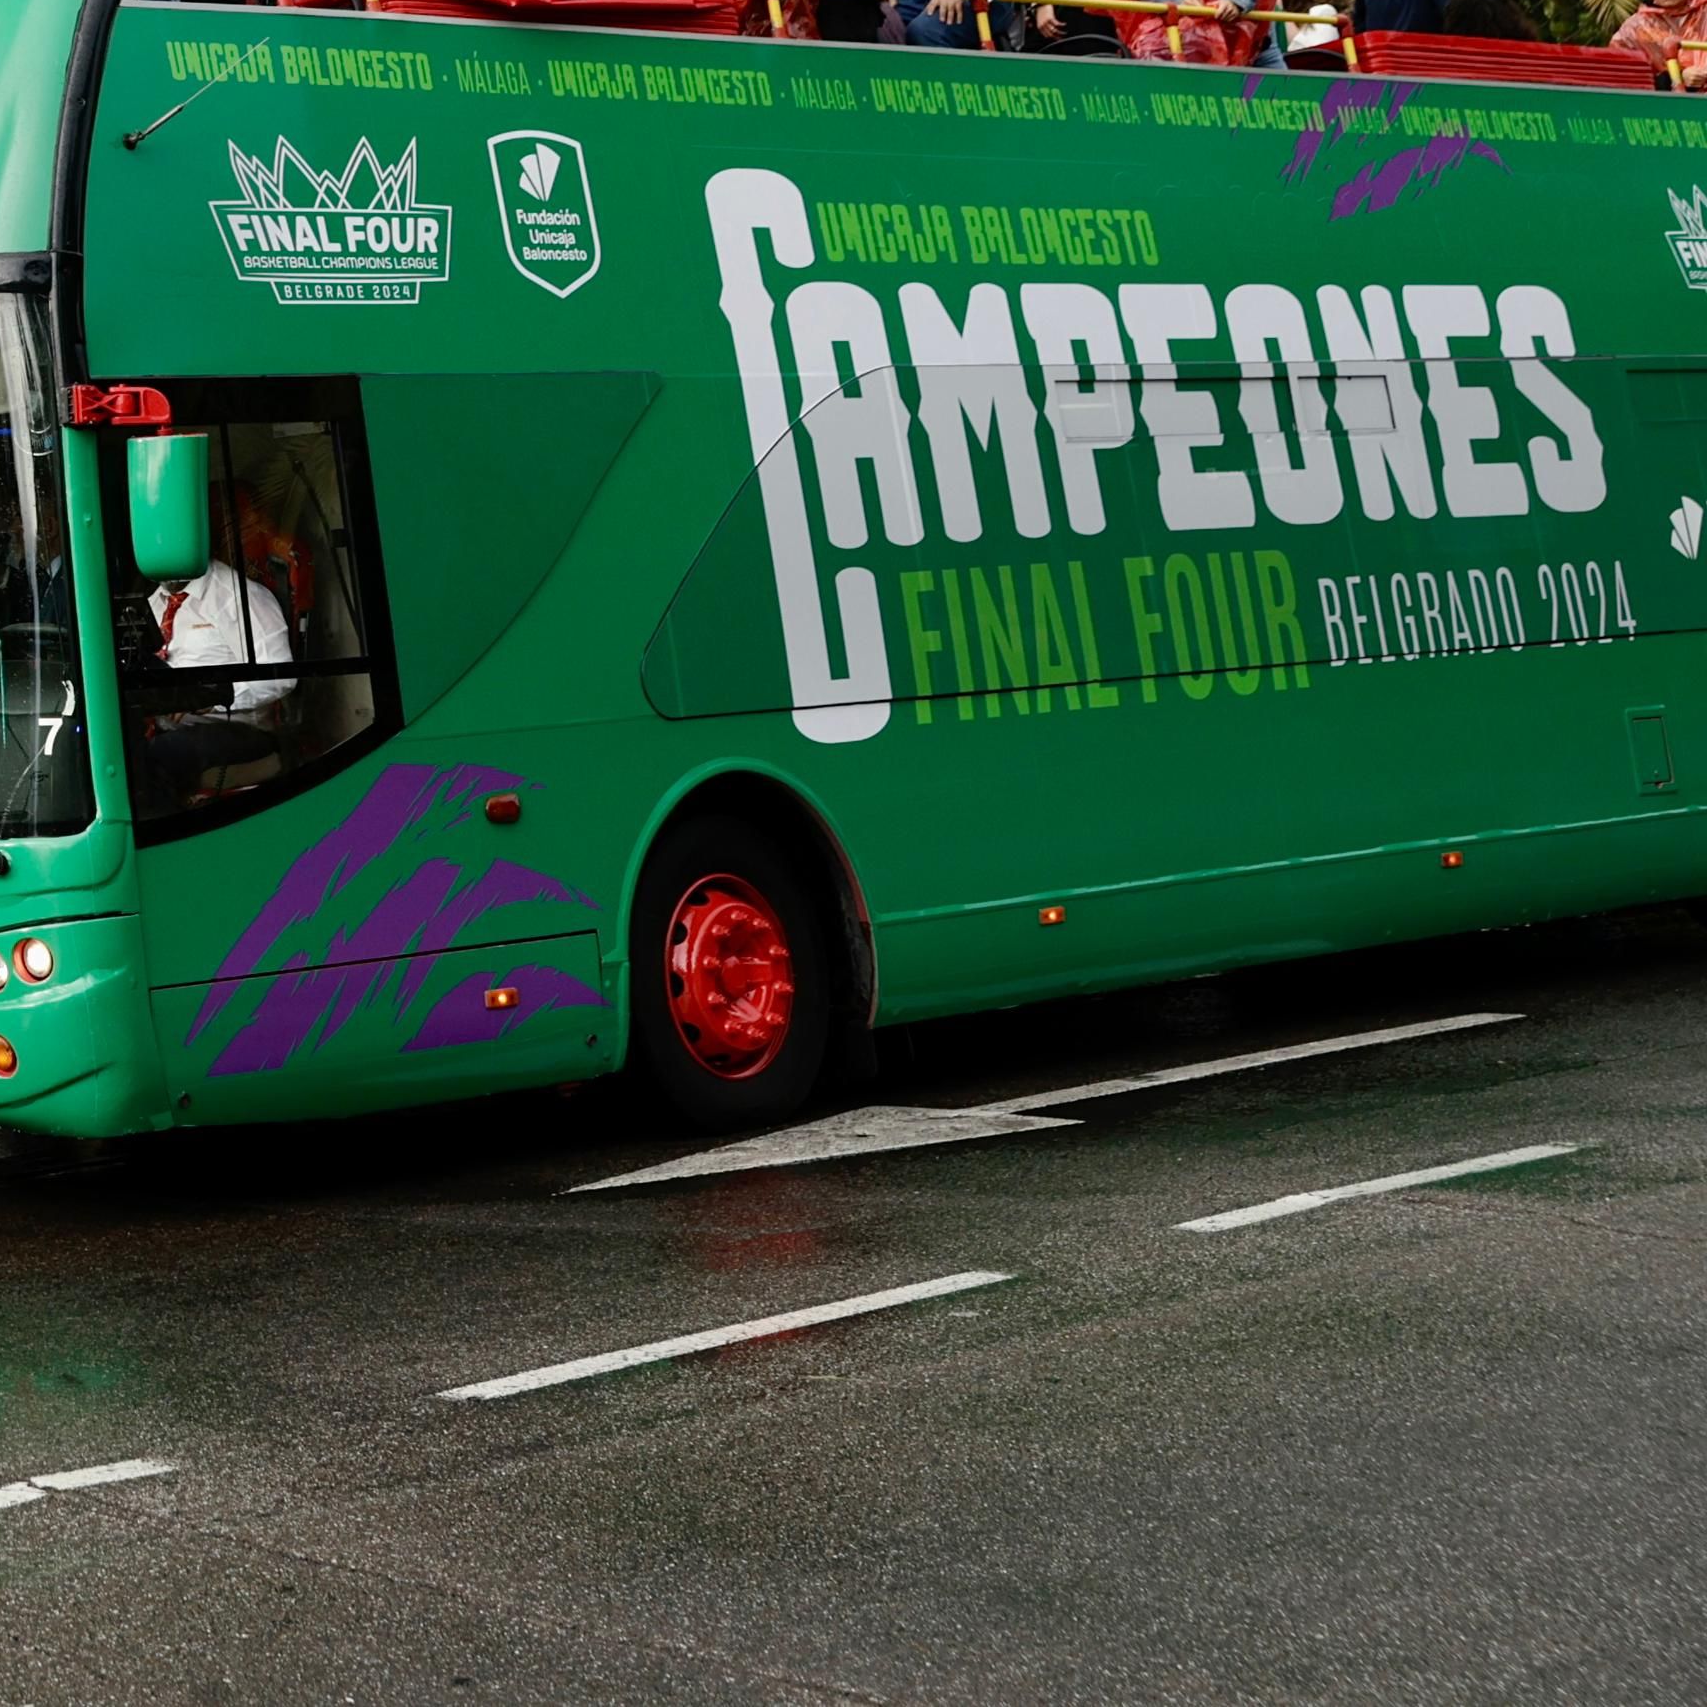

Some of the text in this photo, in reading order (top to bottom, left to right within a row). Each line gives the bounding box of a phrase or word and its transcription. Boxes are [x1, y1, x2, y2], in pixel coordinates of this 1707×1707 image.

[166, 41, 275, 83] UNICAJA
[280, 45, 434, 91] BALONCESTO
[455, 51, 532, 95] MÁLAGA
[547, 60, 638, 100] UNICAJA
[642, 65, 773, 106] BALONCESTO
[791, 69, 857, 111] MÁLAGA
[870, 78, 950, 115] UNICAJA
[951, 82, 1067, 121] BALONCESTO
[1081, 86, 1141, 124] MÁLAGA
[1150, 93, 1222, 128] UNICAJA
[1223, 97, 1326, 132] BALONCESTO
[1399, 105, 1465, 139] UNICAJA
[1464, 109, 1557, 142] BALONCESTO
[227, 214, 439, 253] FINAL FOUR
[516, 208, 581, 226] Fundación
[815, 201, 1160, 267] UNICAJA BALONCESTO
[522, 246, 588, 261] Baloncesto
[529, 228, 576, 249] Unicaja
[243, 256, 439, 270] BASKETBALL CHAMPIONS LEAGUE
[284, 285, 411, 299] BELGRADE 2024
[704, 168, 1607, 744] CAMPEONES
[1318, 560, 1637, 668] BELGRADO 2024
[900, 548, 1312, 726] FINAL FOUR
[38, 718, 63, 755] 7
